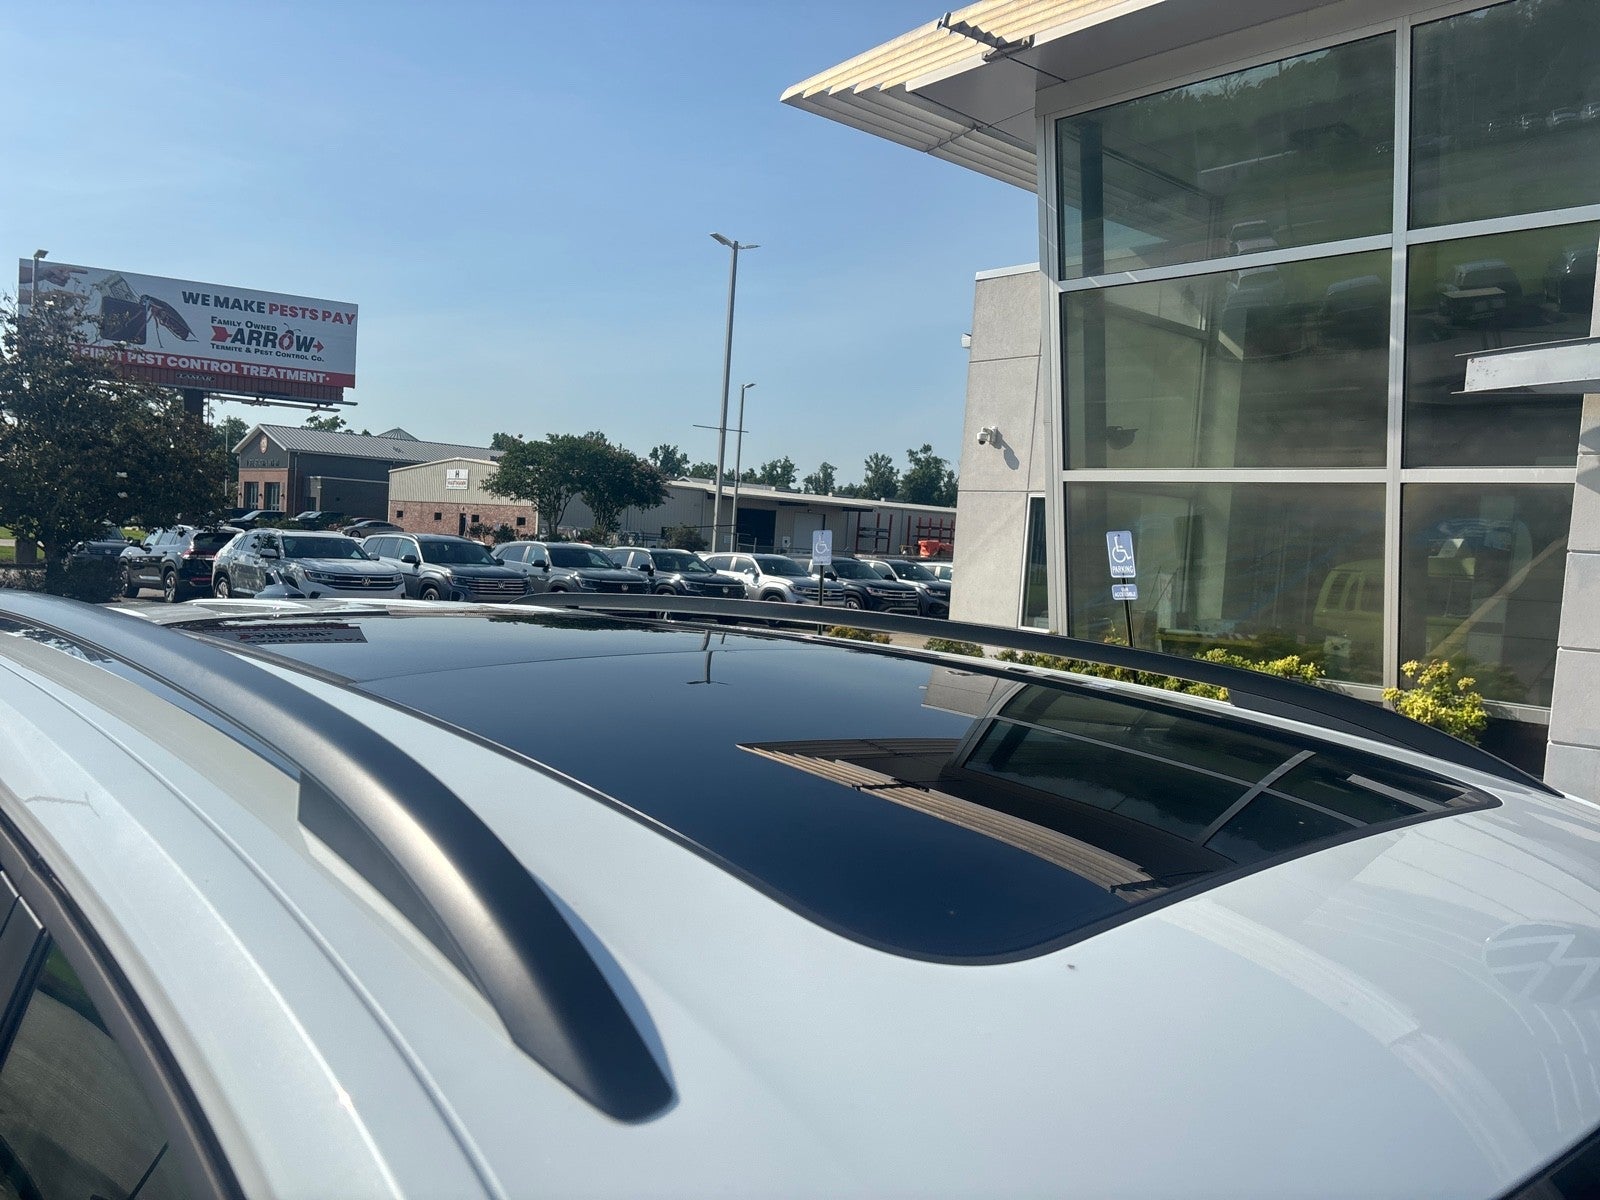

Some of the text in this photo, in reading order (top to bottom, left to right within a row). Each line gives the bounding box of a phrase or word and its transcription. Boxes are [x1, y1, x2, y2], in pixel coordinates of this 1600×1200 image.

[182, 291, 356, 325] WE MAKE PESTS PAY
[230, 327, 315, 353] ARROW
[127, 351, 164, 366] PEST
[166, 356, 239, 375] CONTROL
[1112, 565, 1134, 574] PARKING
